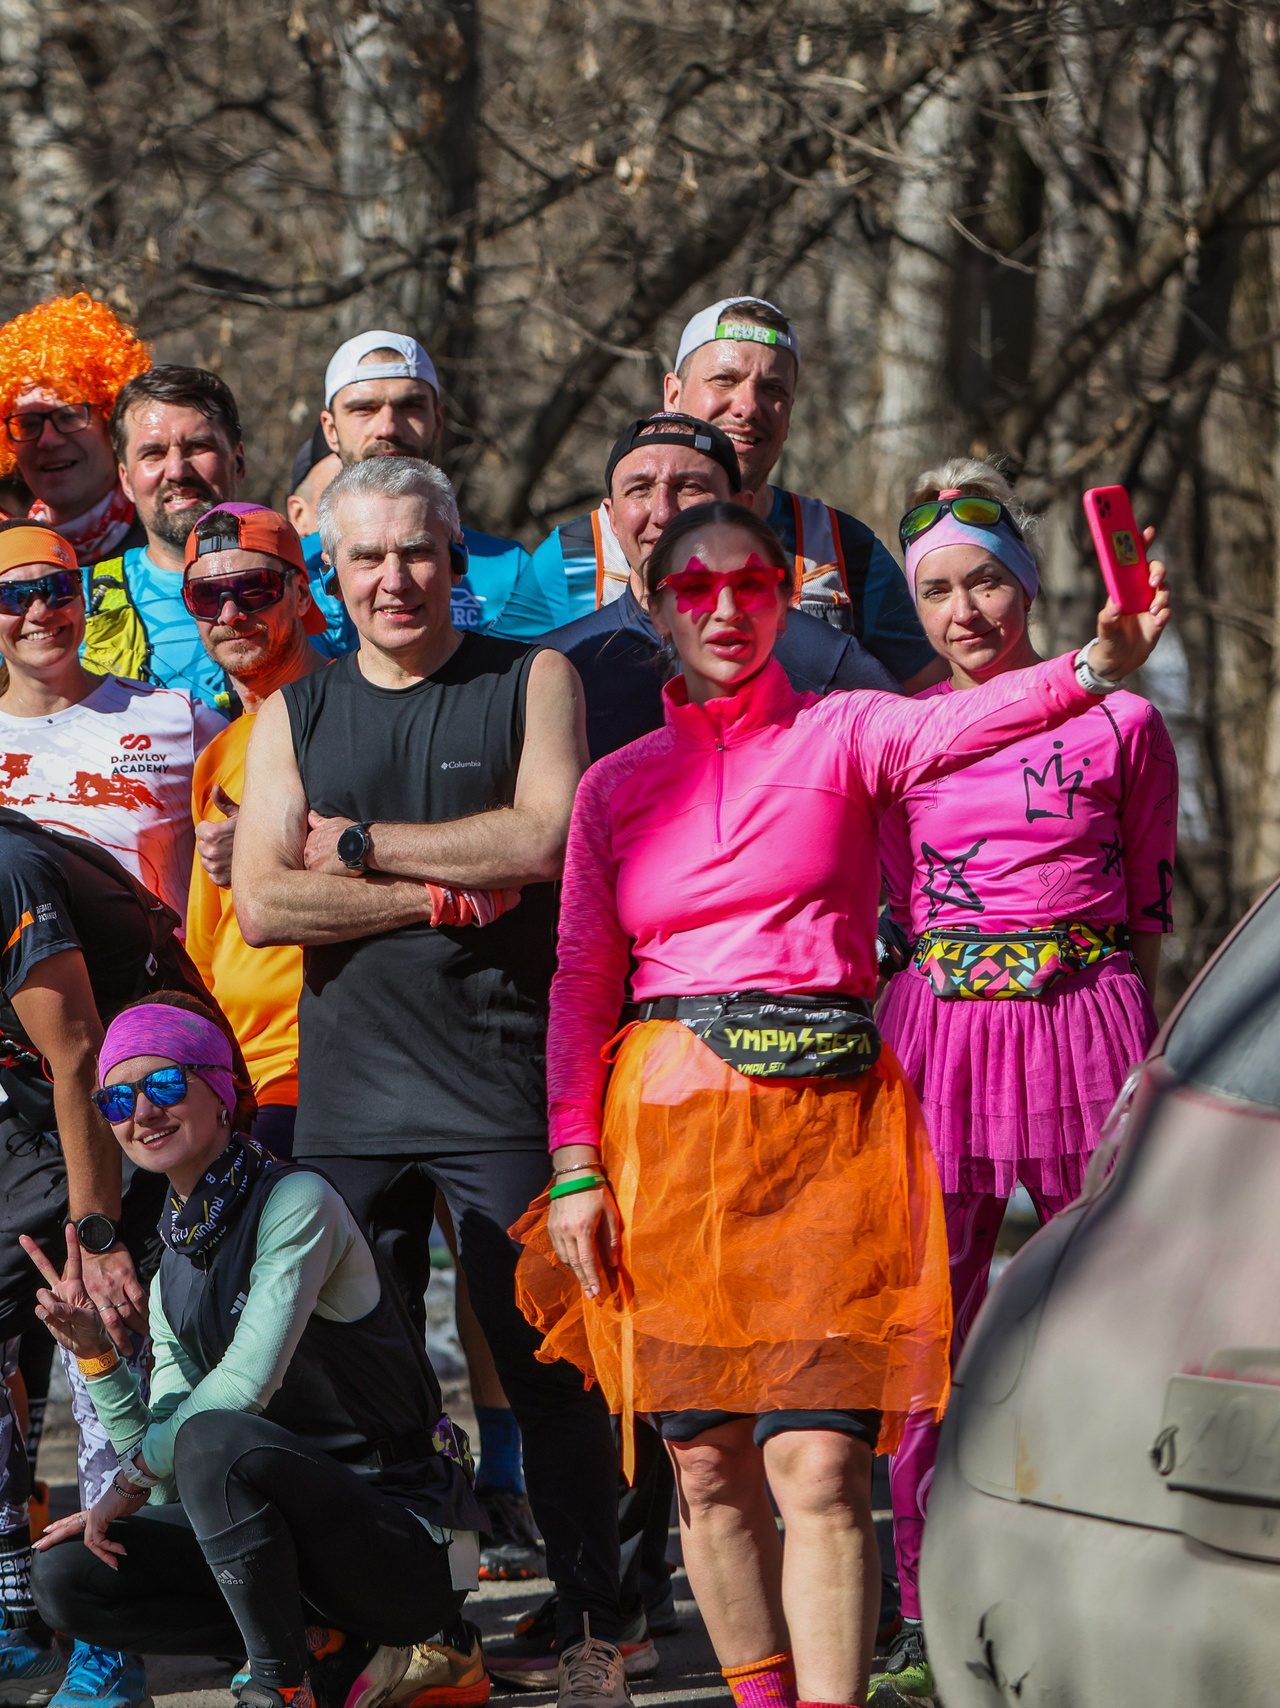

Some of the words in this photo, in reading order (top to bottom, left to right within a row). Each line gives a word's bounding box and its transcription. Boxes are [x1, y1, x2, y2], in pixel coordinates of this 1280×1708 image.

[111, 753, 167, 764] D.PAVLOV
[112, 764, 169, 774] ACADEMY
[448, 760, 481, 769] Columbia
[724, 1028, 798, 1053] УМРИ
